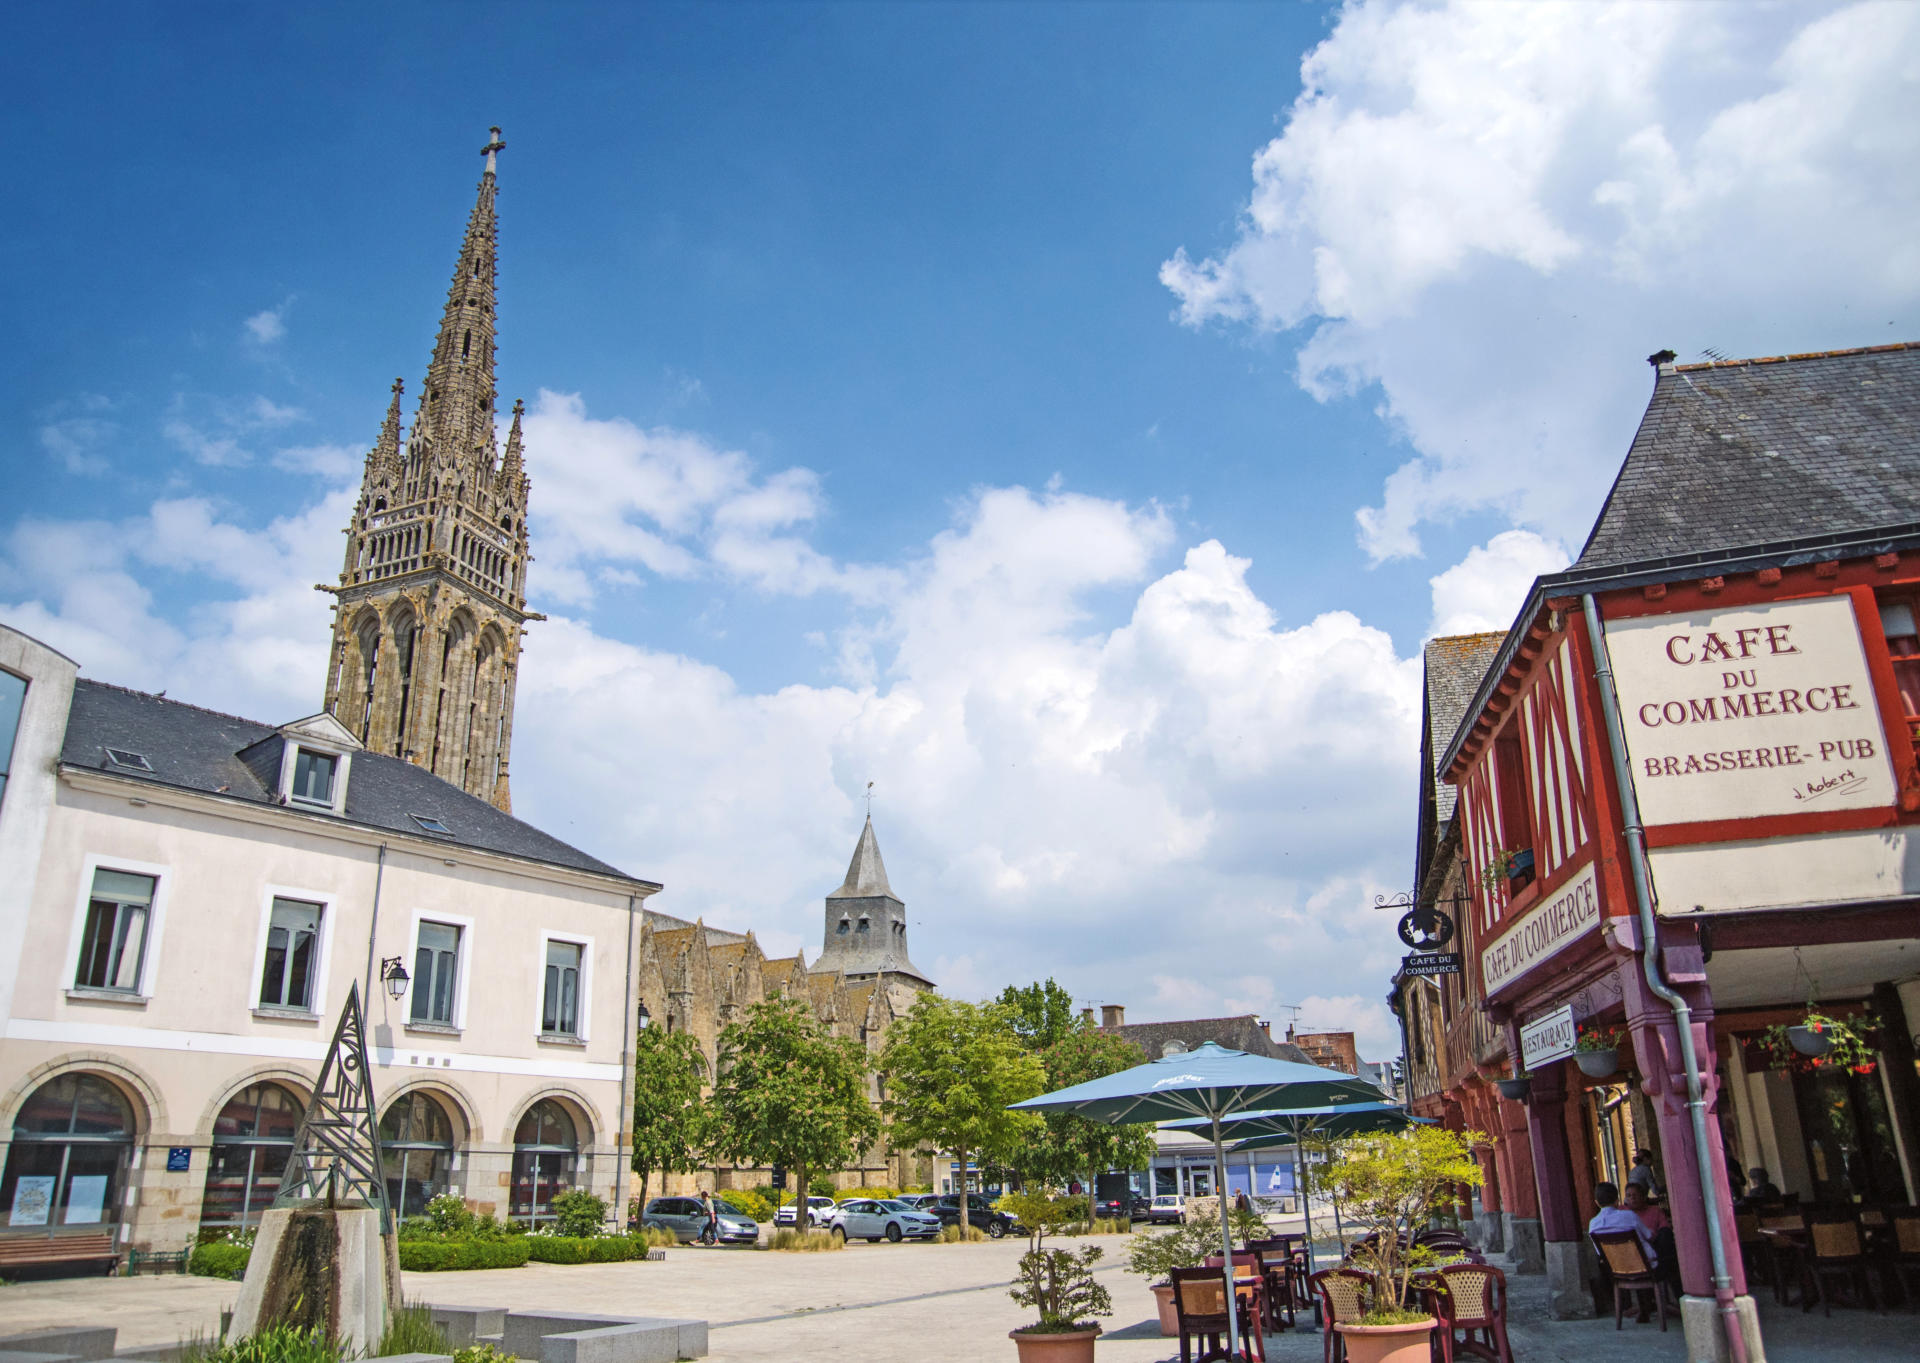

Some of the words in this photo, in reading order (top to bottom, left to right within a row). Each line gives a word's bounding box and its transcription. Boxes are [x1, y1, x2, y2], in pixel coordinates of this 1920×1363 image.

[1665, 624, 1802, 666] CAFE
[1722, 669, 1759, 690] DU
[1638, 684, 1860, 728] COMMERCE
[1818, 738, 1876, 763] PUB
[1807, 769, 1856, 795] Robert
[1485, 943, 1510, 984] CAFE
[1510, 930, 1524, 968] DU
[1524, 876, 1598, 959] COMMERCE
[1405, 964, 1459, 976] COMMERCE
[1409, 956, 1436, 966] CAFE
[1438, 955, 1451, 964] DU
[1523, 1019, 1572, 1057] RESTAURANT
